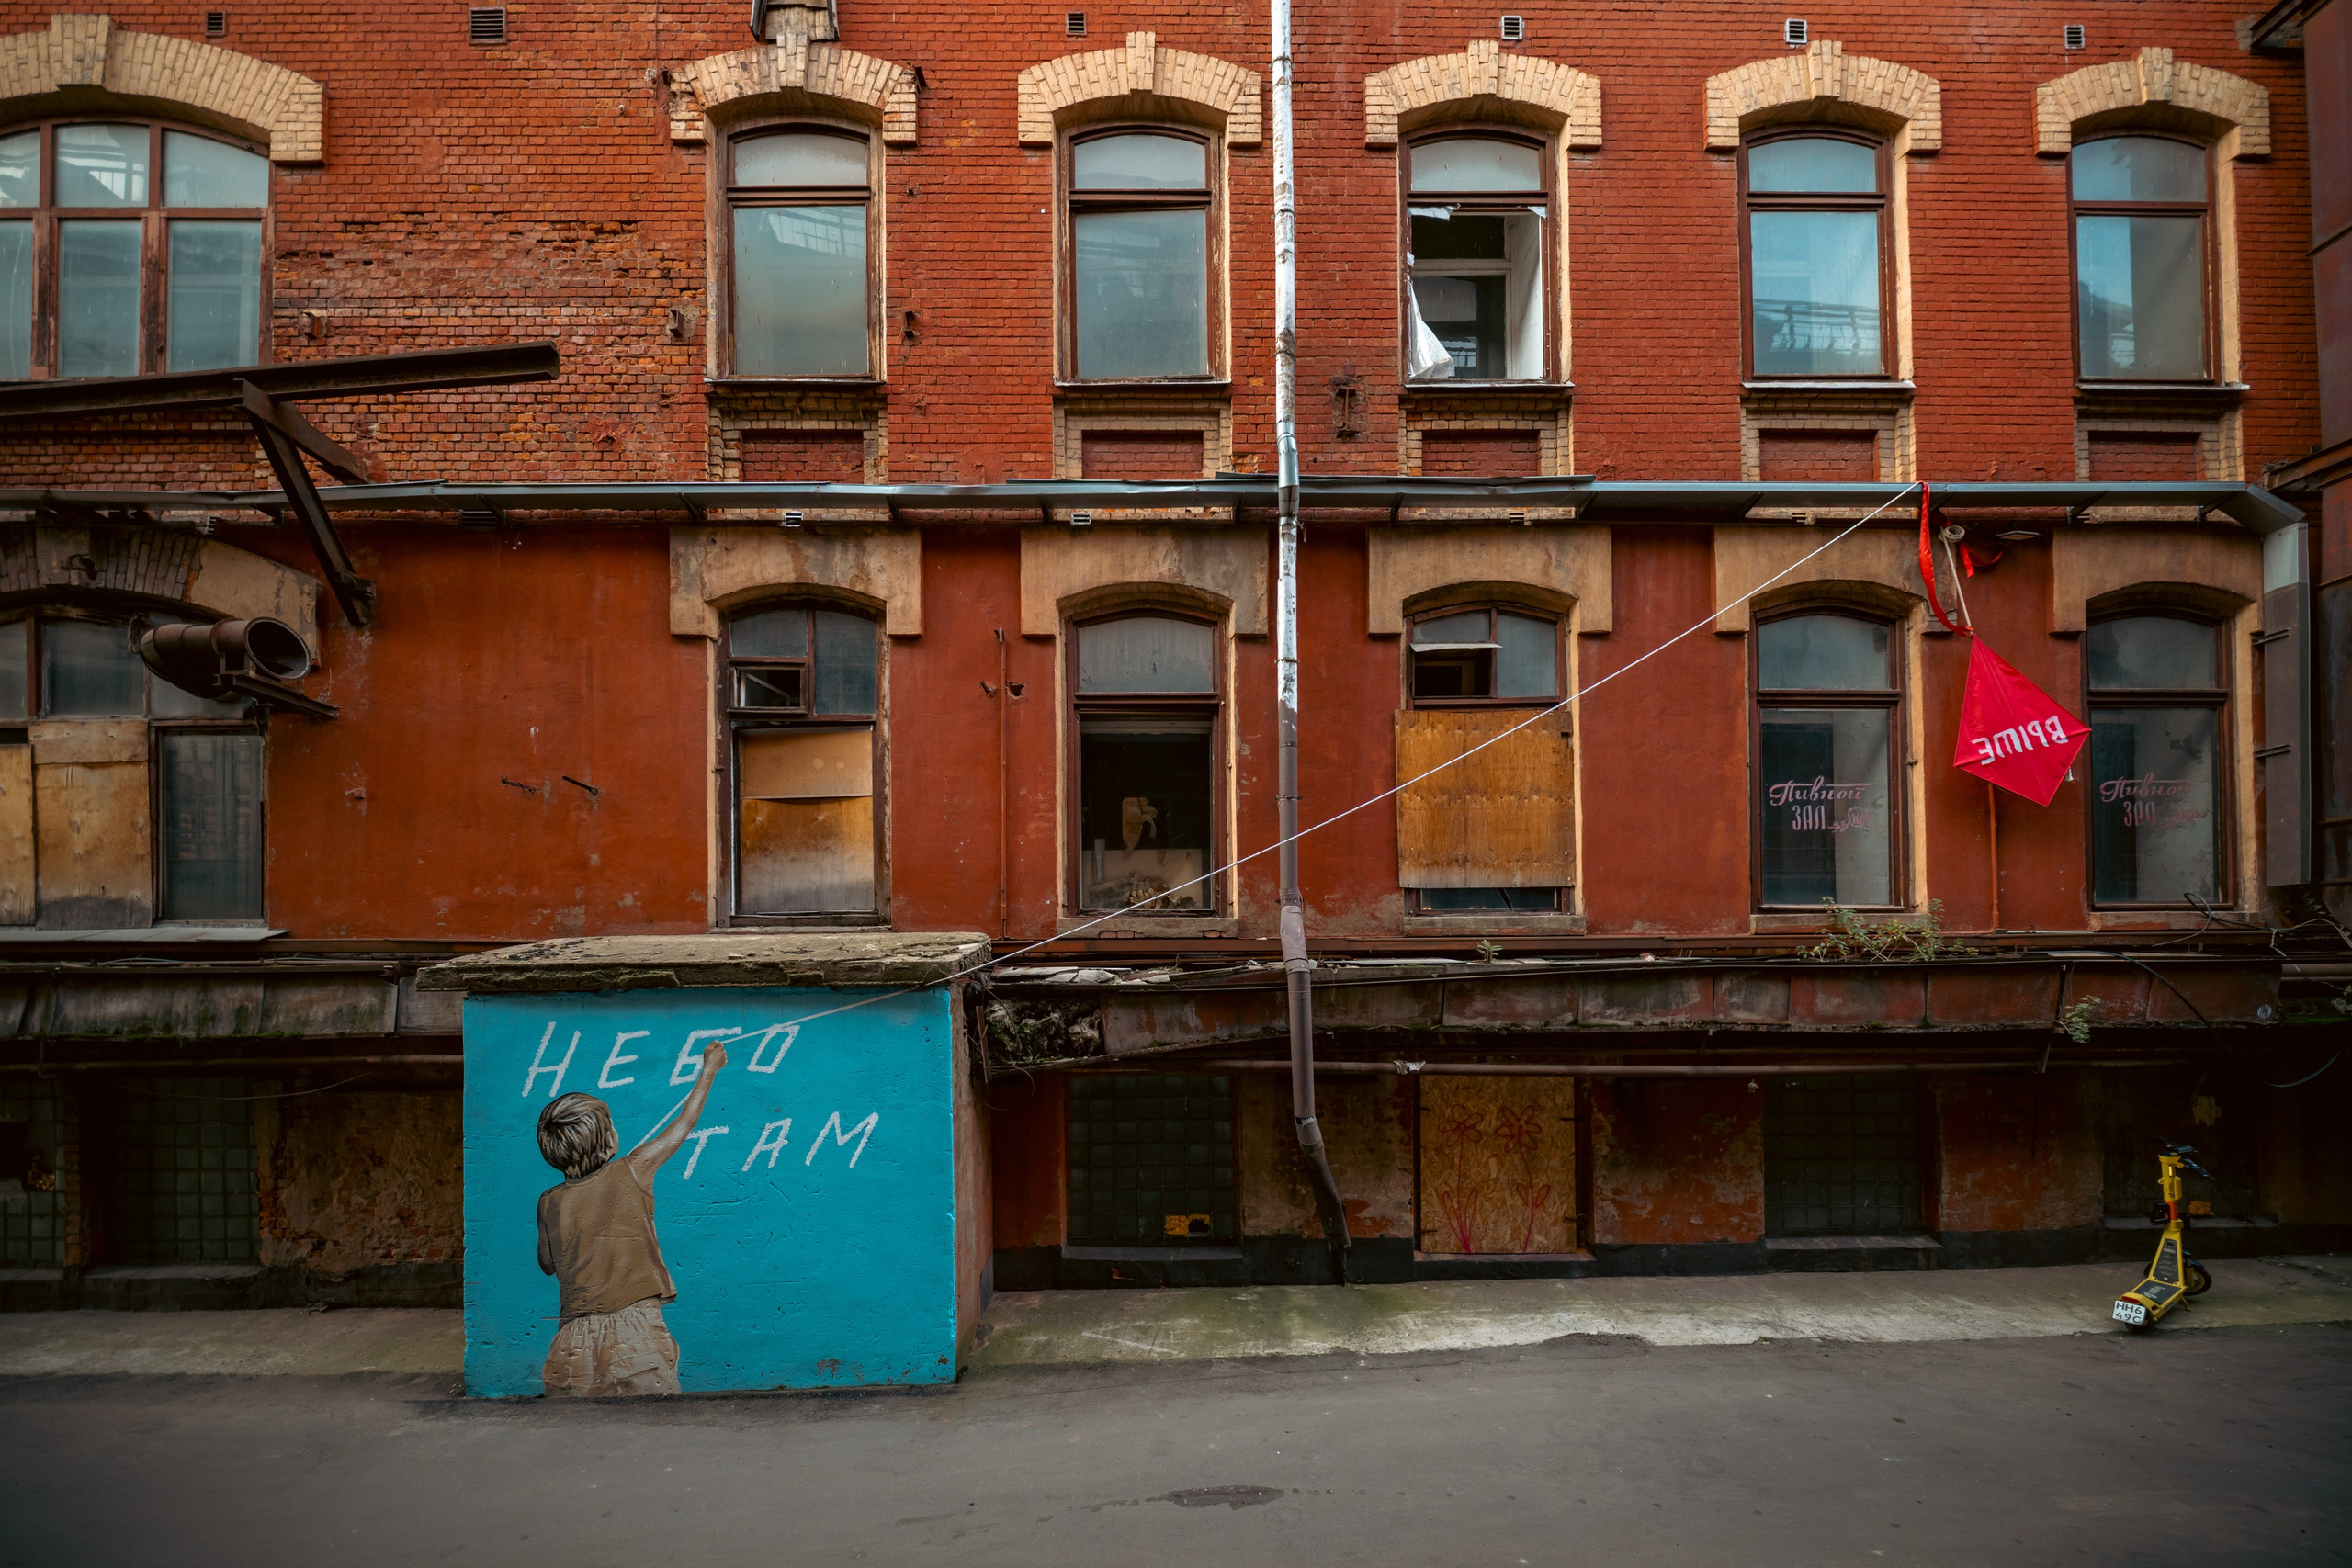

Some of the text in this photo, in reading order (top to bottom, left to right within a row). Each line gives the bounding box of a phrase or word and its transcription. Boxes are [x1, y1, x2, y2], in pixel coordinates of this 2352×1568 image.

[1971, 715, 2069, 765] ВЫШЕ
[1769, 775, 1876, 807] Пивной
[1792, 805, 1826, 830] ЗАЛ
[521, 1021, 800, 1098] НЕБО
[683, 1111, 879, 1180] ТАМ
